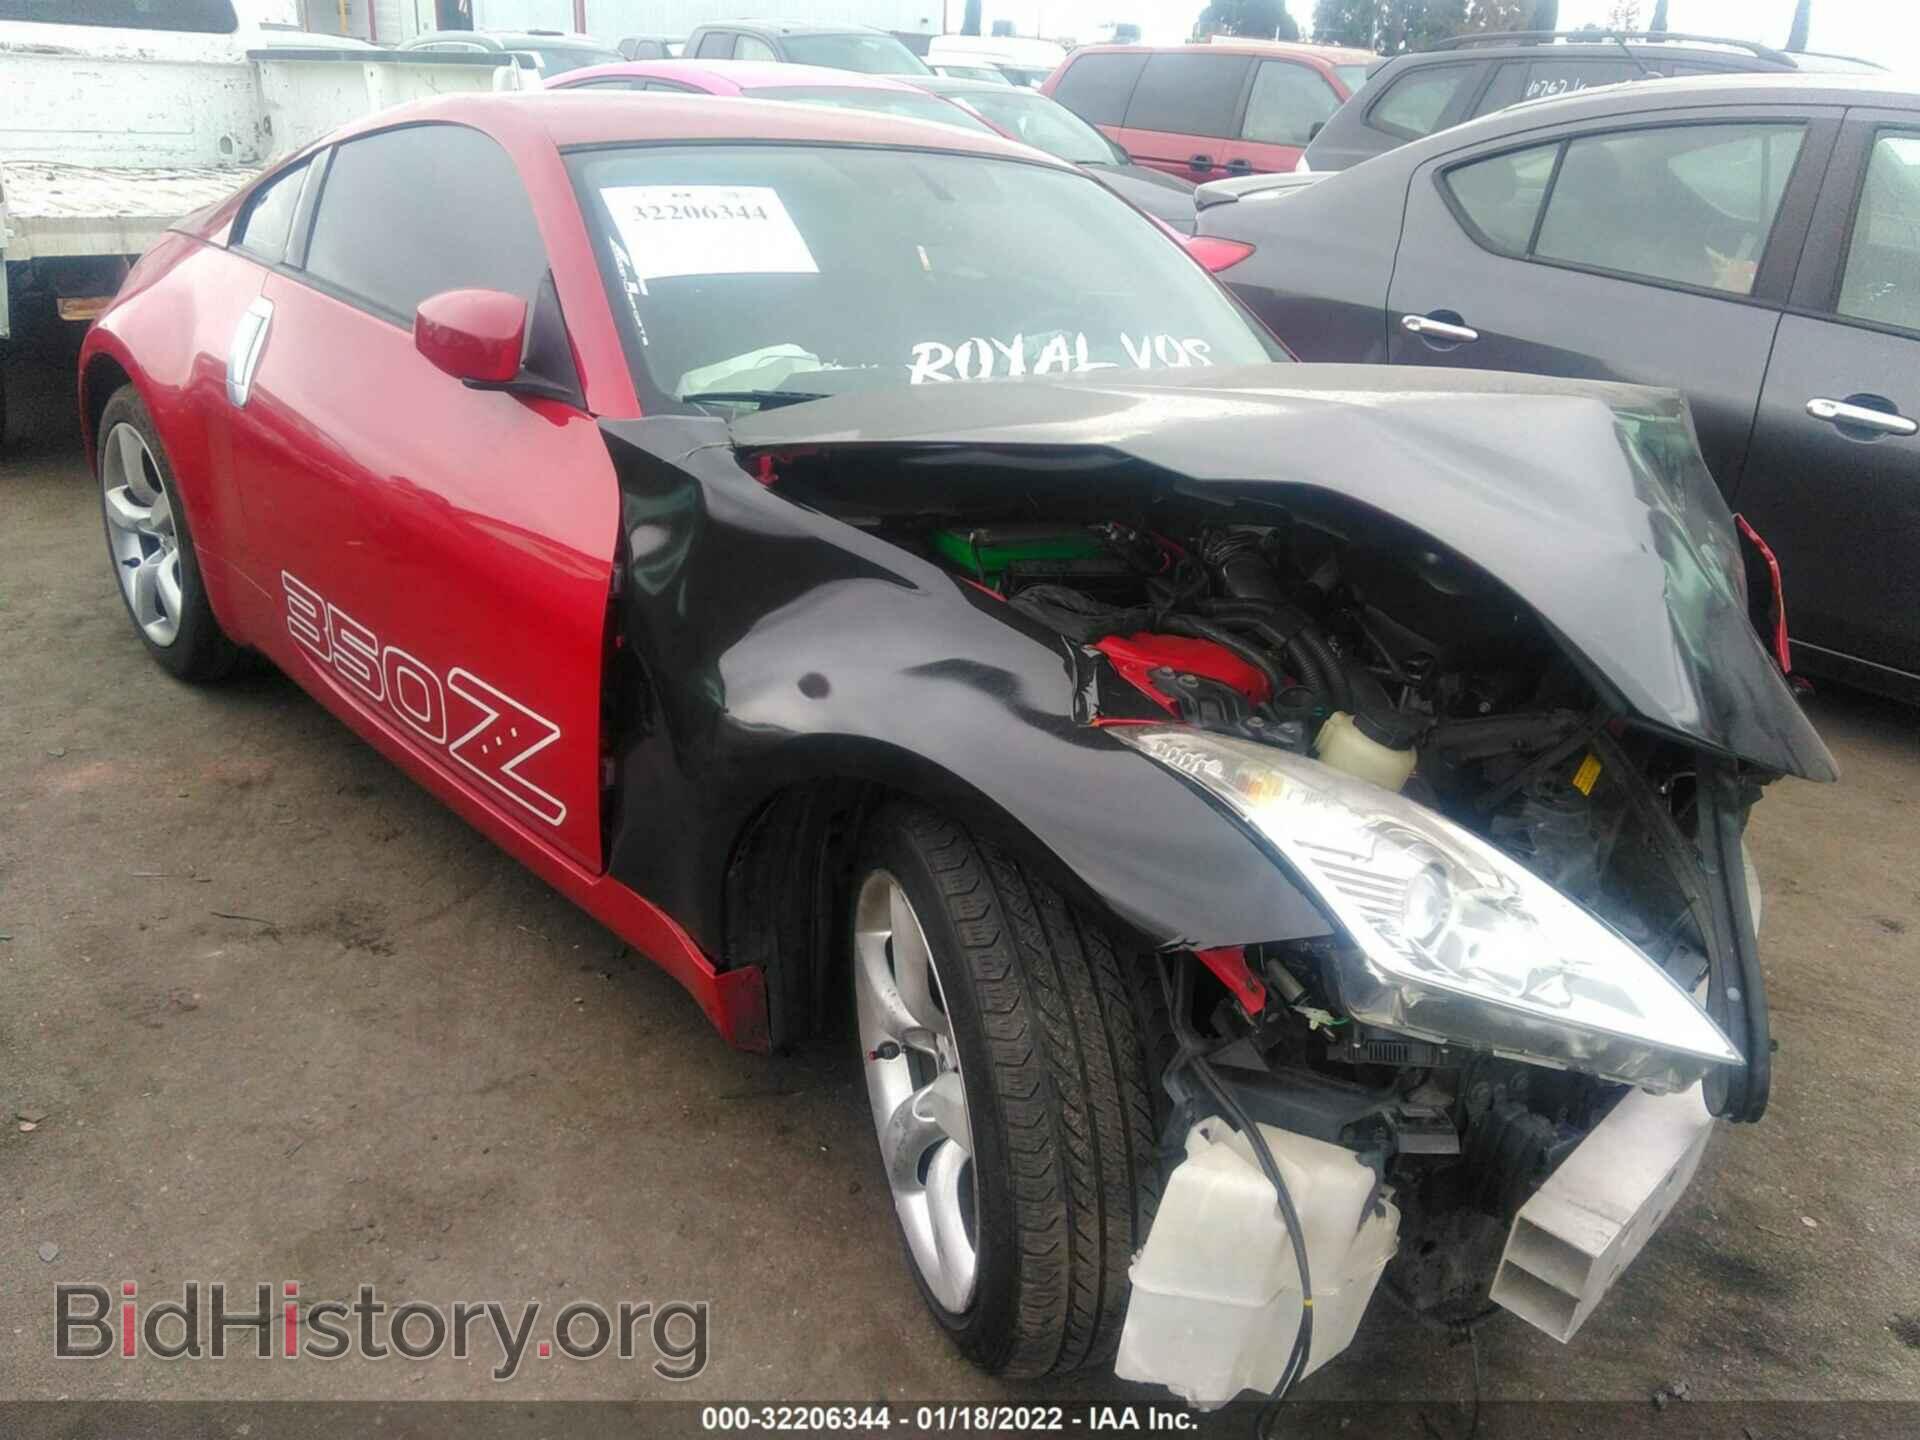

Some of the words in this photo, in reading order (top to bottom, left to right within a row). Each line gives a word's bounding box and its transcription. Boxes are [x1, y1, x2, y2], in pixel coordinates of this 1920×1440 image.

[632, 203, 768, 222] 32206344
[905, 330, 1119, 385] ROYAL
[280, 569, 568, 827] 350Z
